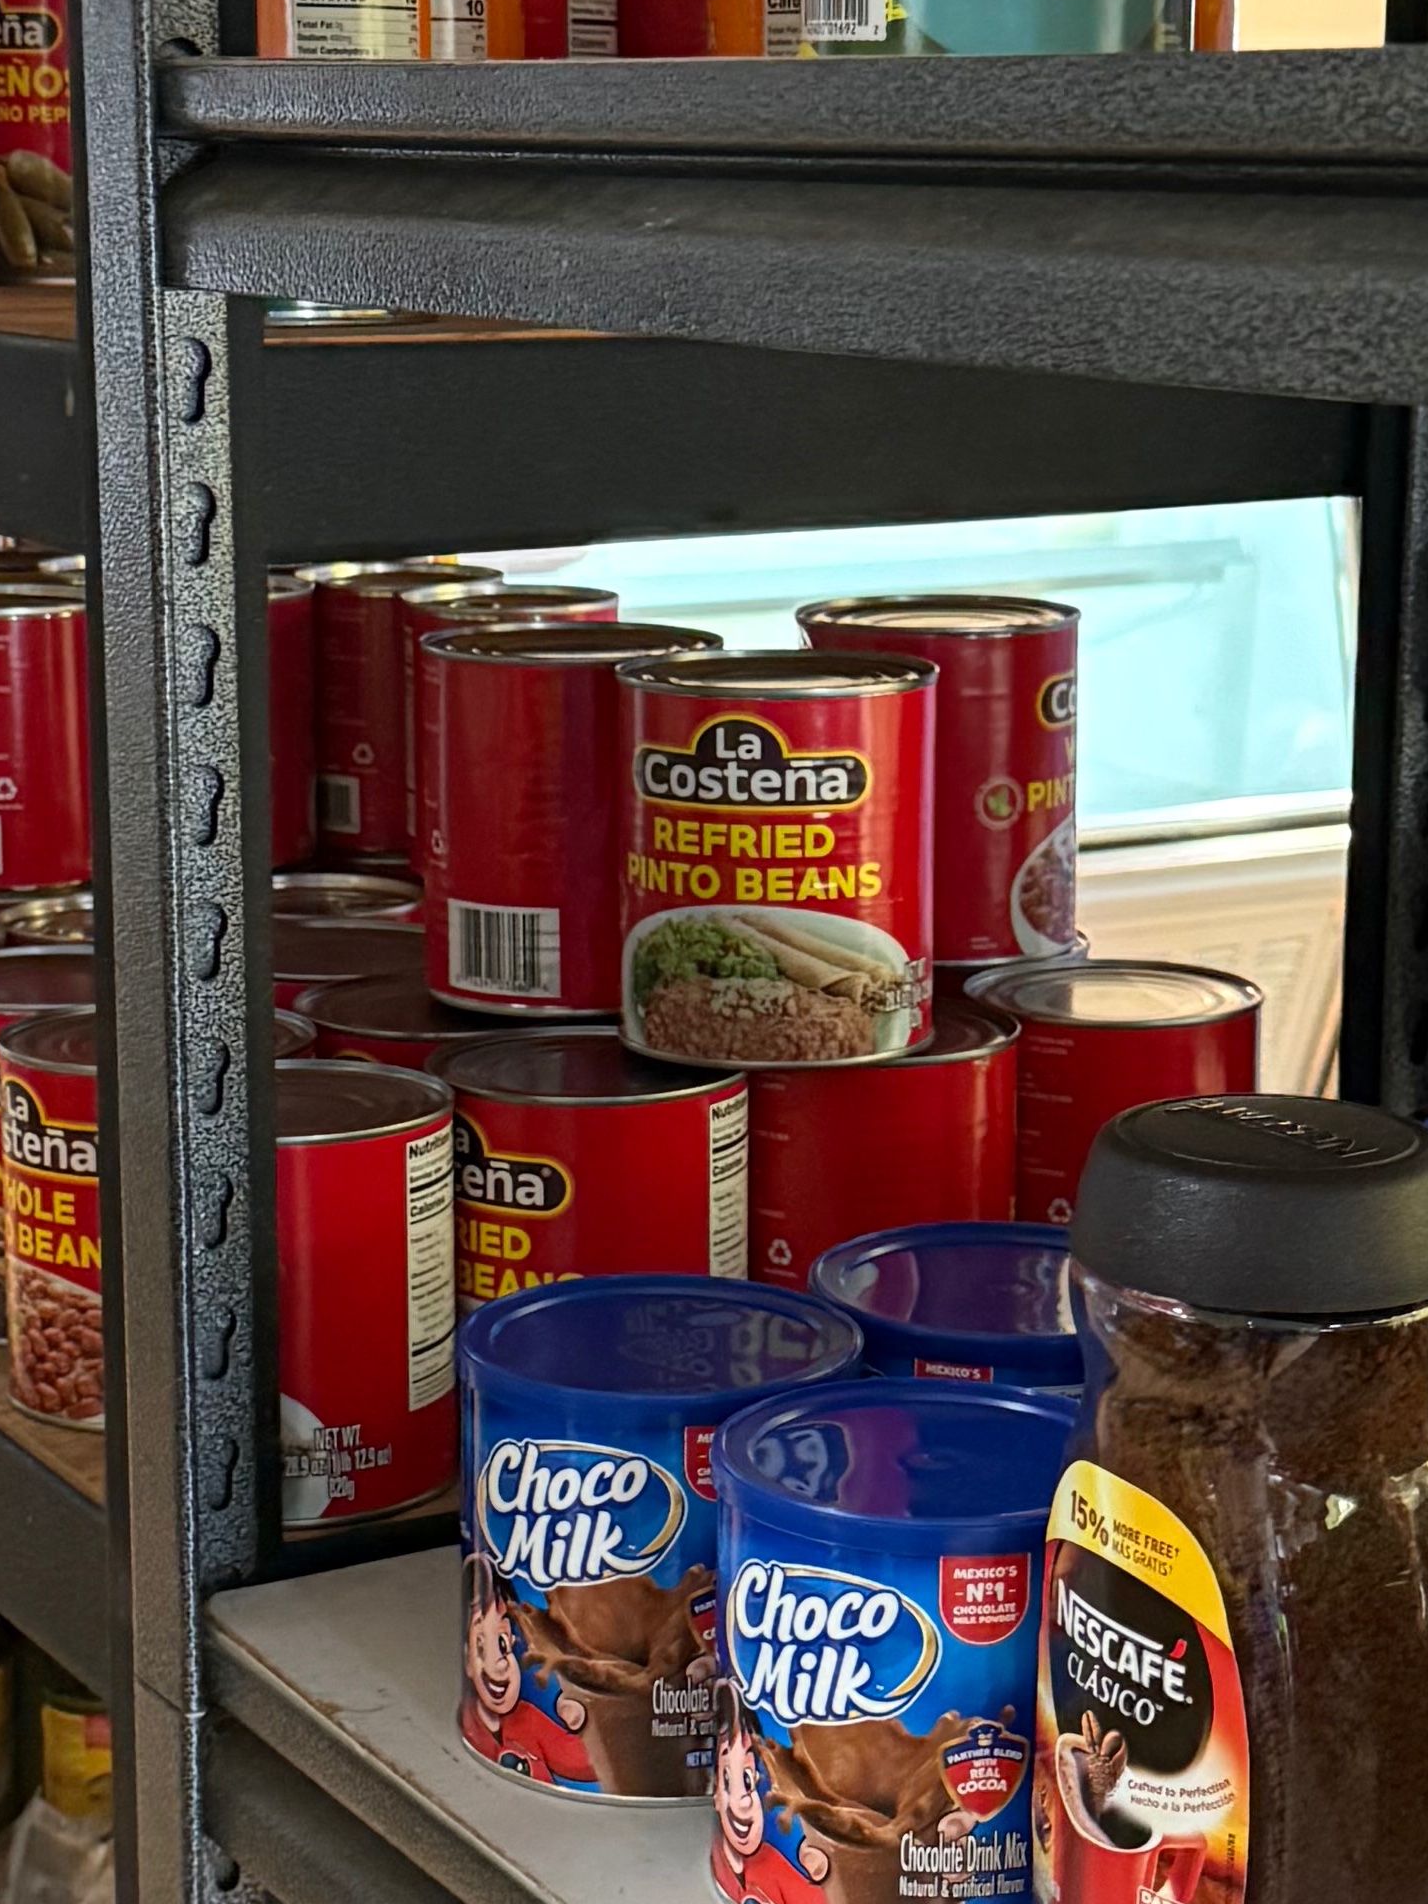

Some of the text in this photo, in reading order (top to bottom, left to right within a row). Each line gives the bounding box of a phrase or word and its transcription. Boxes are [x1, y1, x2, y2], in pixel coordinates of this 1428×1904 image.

[715, 726, 763, 762] La
[642, 751, 851, 804] Costeña
[652, 815, 837, 860] REFRIED
[626, 852, 884, 903] PINTO BEANS
[5, 1080, 30, 1122] La
[314, 1426, 340, 1451] NET
[486, 1444, 649, 1516] Choco
[1069, 1489, 1142, 1548] 15% MORE
[500, 1511, 637, 1583] Milk
[1112, 1536, 1132, 1561] MÁS
[952, 1565, 1018, 1580] MEXICO'S
[734, 1563, 901, 1643] Choco
[952, 1602, 1016, 1616] CHOCOLATE
[1056, 1576, 1189, 1704] NESCAFÉ
[651, 1679, 711, 1714] Chocolate
[746, 1642, 878, 1719] Milk
[1066, 1650, 1157, 1726] CLÁSICO
[956, 1778, 1008, 1795] COCOA
[970, 1766, 1001, 1779] REAL
[900, 1830, 1028, 1874] Chocolate Drink Mix
[898, 1874, 995, 1898] Natural & artificial
